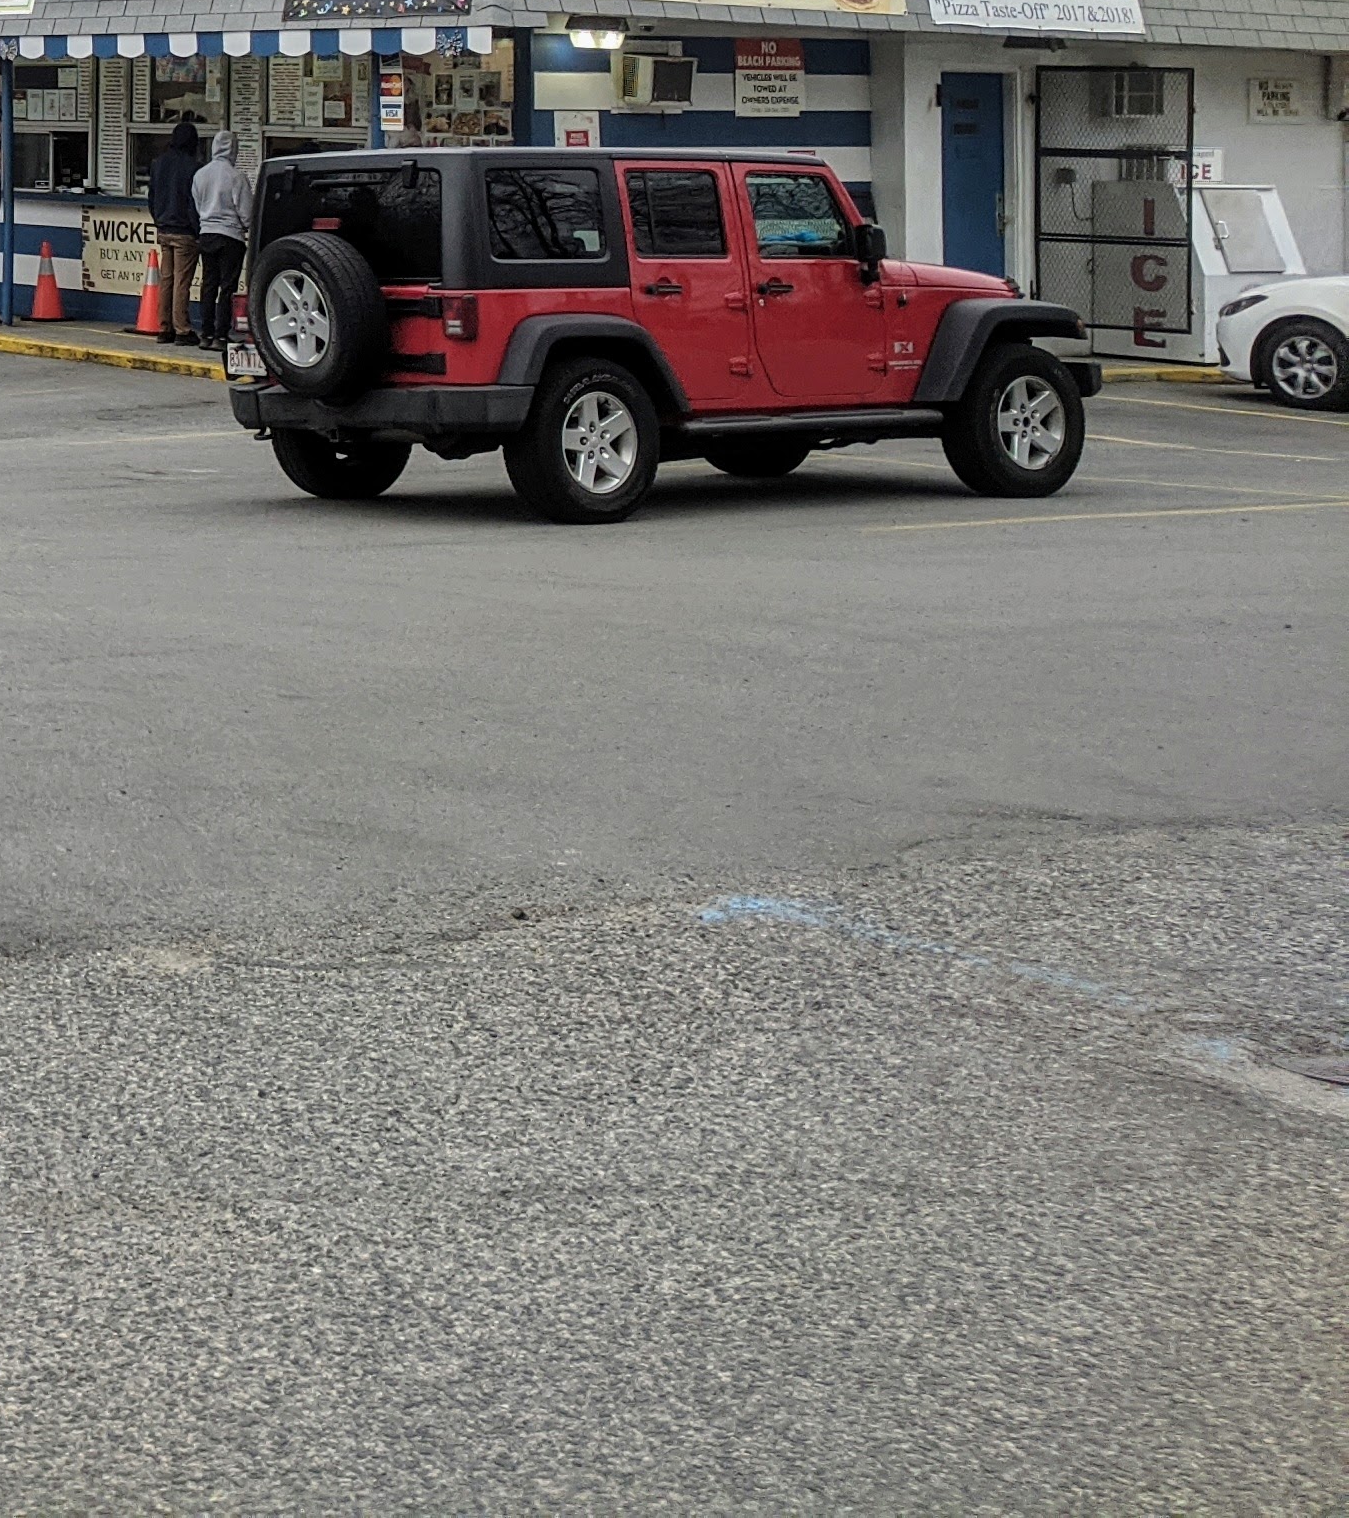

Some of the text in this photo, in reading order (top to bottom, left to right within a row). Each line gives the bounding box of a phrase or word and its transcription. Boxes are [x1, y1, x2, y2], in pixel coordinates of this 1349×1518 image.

[761, 41, 777, 54] NO
[738, 55, 801, 67] BEACH PARKING
[742, 73, 772, 82] VEHICLES
[753, 85, 788, 93] TOWED AT
[1181, 162, 1211, 179] ICE
[93, 219, 159, 244] WICKE
[100, 248, 144, 262] BUY ANY
[101, 269, 116, 279] GET
[118, 271, 129, 281] AN
[1130, 198, 1169, 348] ICE
